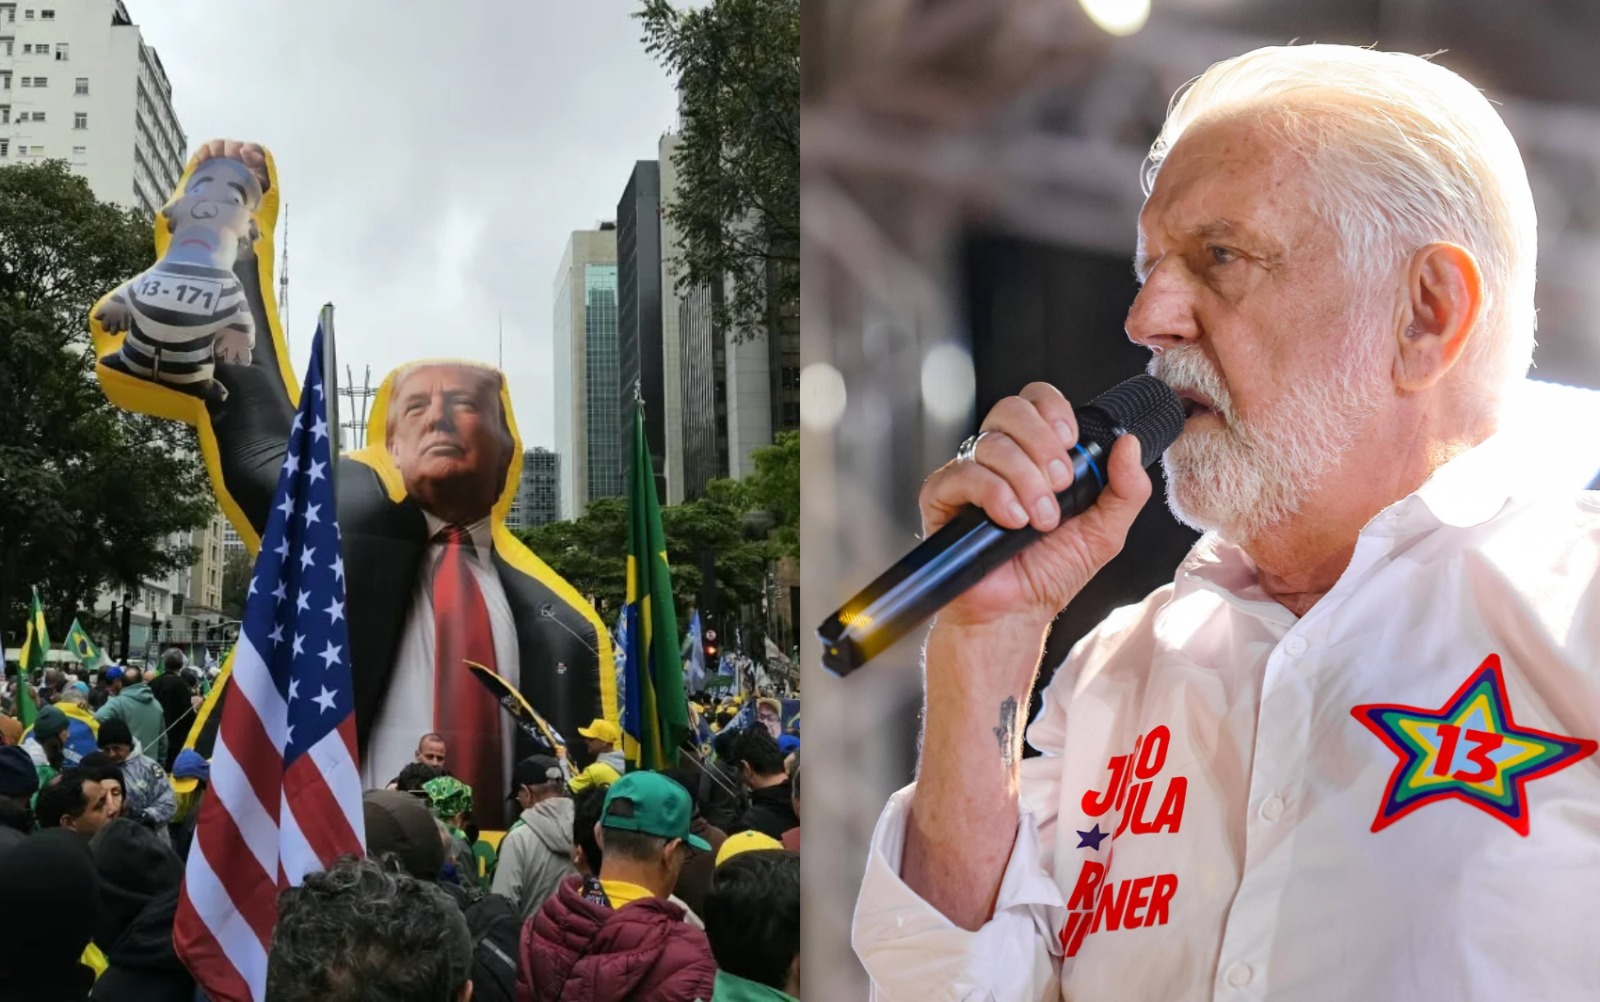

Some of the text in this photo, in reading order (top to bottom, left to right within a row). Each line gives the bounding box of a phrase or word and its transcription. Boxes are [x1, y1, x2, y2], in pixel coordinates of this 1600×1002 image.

[141, 281, 161, 296] 13
[176, 285, 214, 309] 171
[1433, 724, 1504, 783] 13
